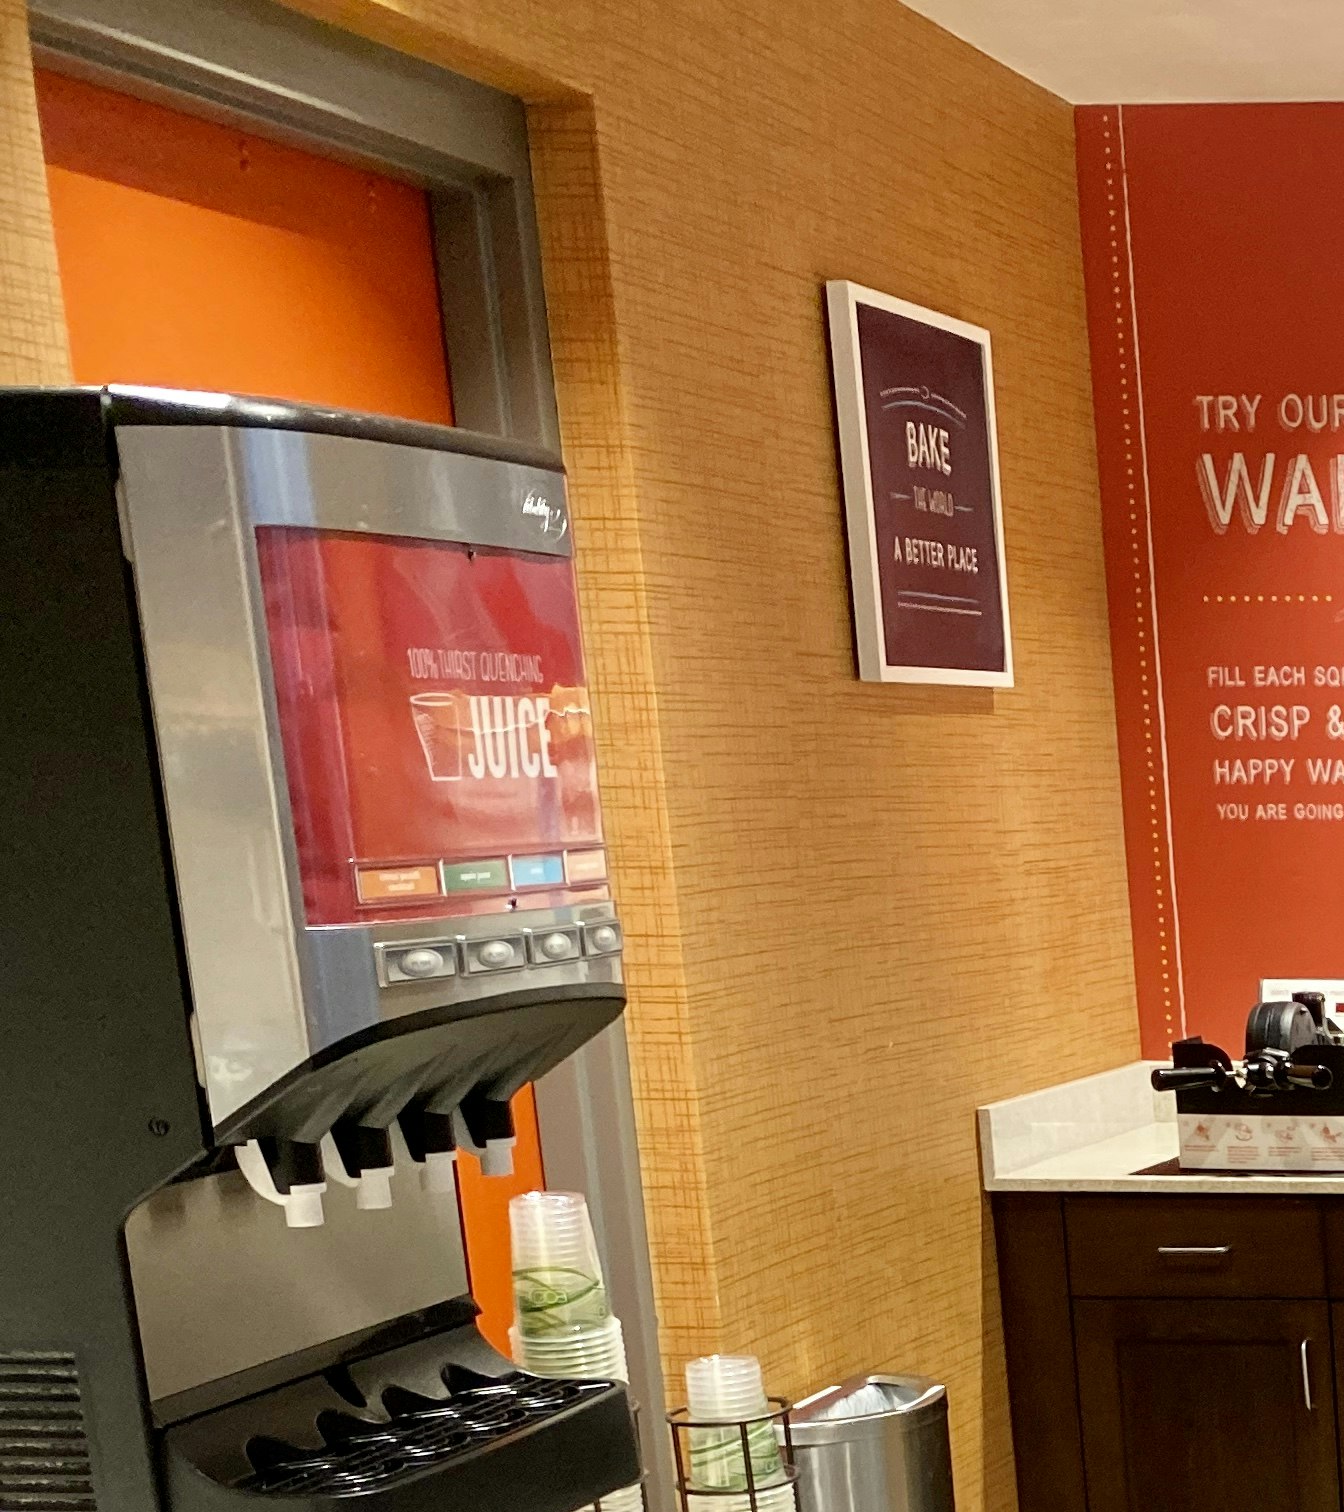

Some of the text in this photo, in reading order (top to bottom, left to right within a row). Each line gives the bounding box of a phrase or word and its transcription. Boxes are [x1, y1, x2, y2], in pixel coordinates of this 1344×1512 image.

[1196, 393, 1262, 431] TRY
[906, 421, 952, 476] BAKE
[894, 535, 979, 575] A BETTER PLACE
[407, 648, 544, 684] 100% THIRST QUENCHING
[1208, 666, 1246, 688] FILL
[1254, 666, 1305, 688] EACH
[468, 696, 558, 779] JUICE
[1210, 705, 1310, 742] CRISP
[1214, 759, 1295, 786] HAPPY
[1217, 803, 1249, 822] YOU
[1255, 803, 1288, 822] ARE
[1293, 803, 1344, 822] GOING
